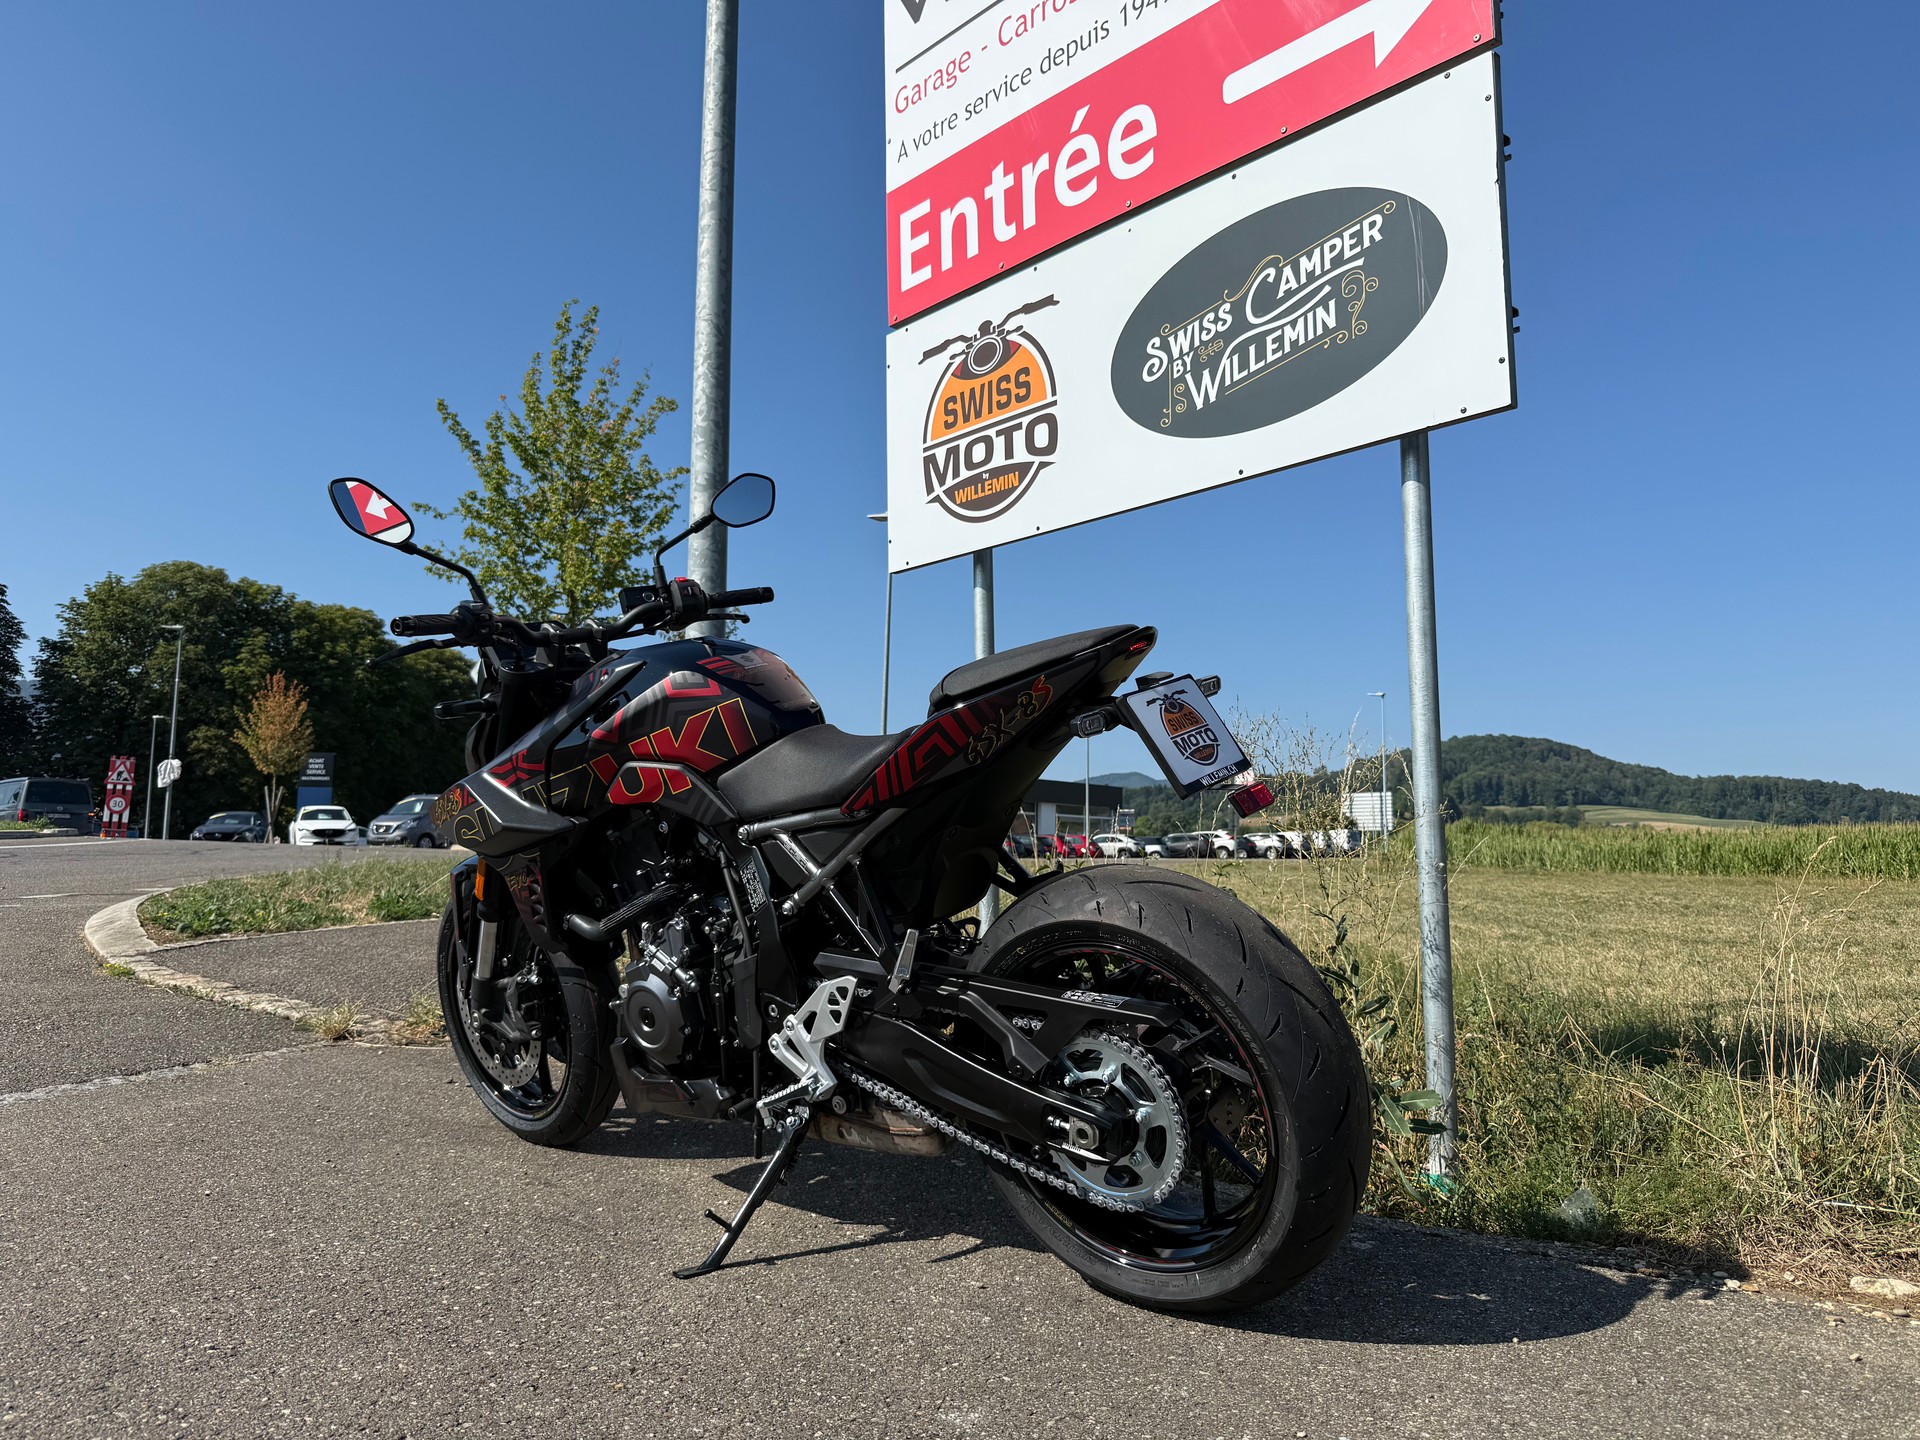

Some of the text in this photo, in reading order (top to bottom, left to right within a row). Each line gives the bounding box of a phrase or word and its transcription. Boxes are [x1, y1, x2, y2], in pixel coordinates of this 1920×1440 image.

[895, 50, 971, 114] Garage
[998, 0, 1086, 47] Carro
[898, 0, 1169, 163] A votre service depuis 19
[900, 103, 1158, 294] Entrée
[1142, 213, 1384, 383] SWISS CAMPER
[1173, 352, 1194, 379] BY
[1185, 285, 1337, 411] WILLEMIN
[943, 366, 1031, 431] SWISS
[923, 412, 1059, 497] MOTO
[954, 471, 1019, 504] WILLEMIN
[1167, 711, 1199, 732] SWISS
[1172, 727, 1219, 757] MOTO
[111, 800, 123, 808] 30
